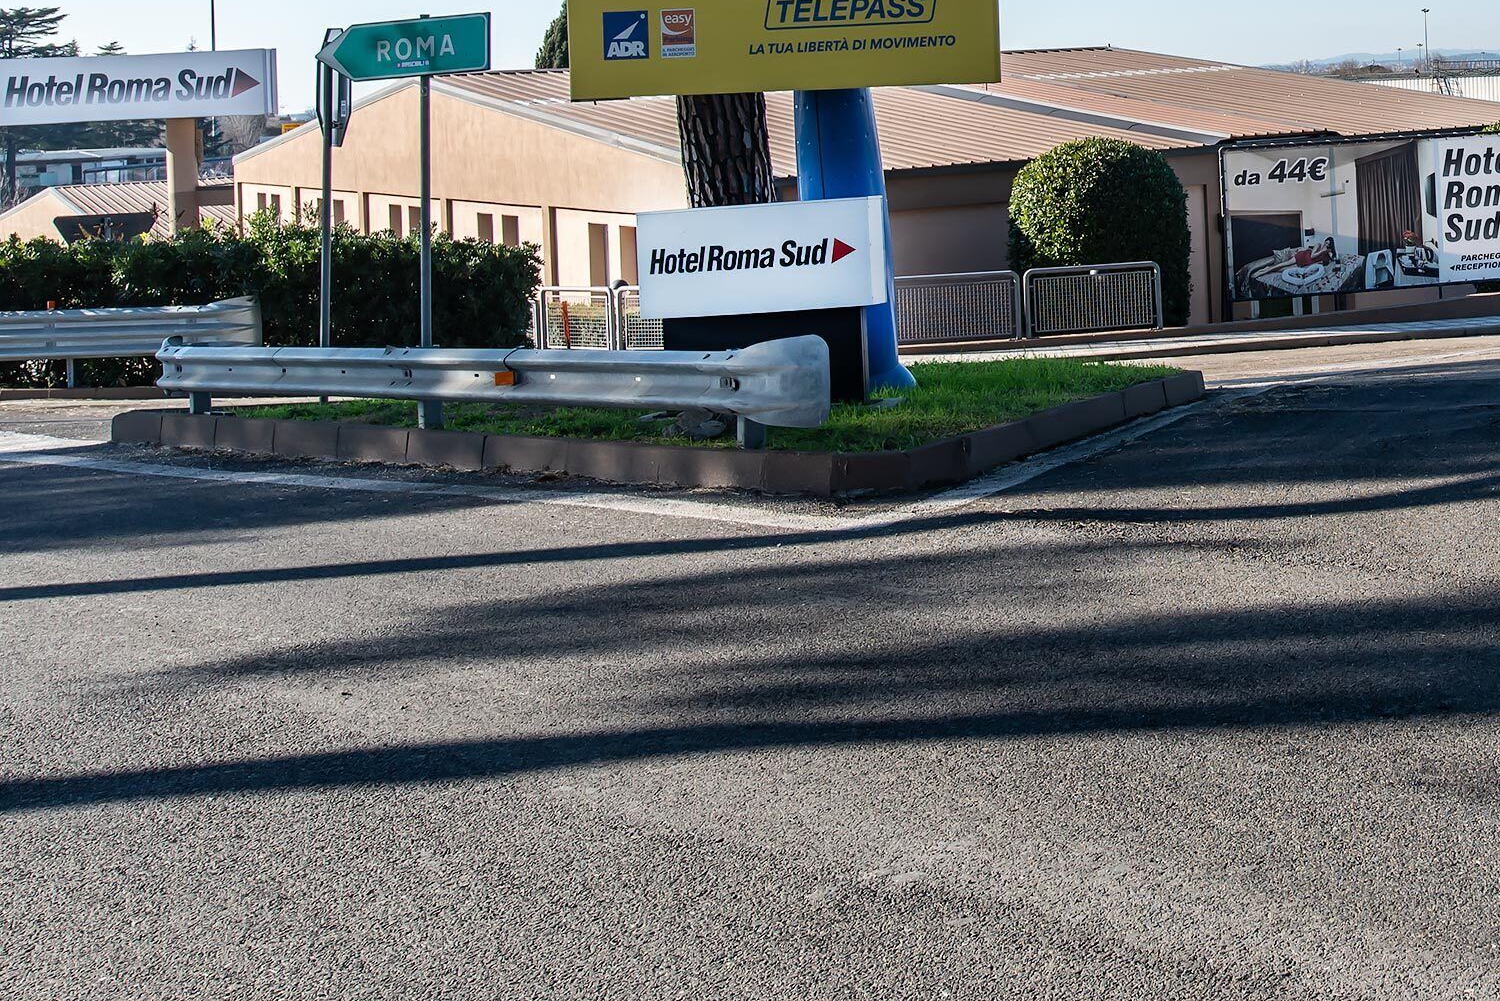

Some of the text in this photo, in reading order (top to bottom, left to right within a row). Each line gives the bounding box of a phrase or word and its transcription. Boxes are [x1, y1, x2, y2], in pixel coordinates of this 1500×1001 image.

[664, 13, 692, 26] easy
[376, 34, 455, 62] ROMA
[607, 40, 646, 58] ADR
[748, 34, 956, 55] LA TUA LIBERTÀ DI MOVIMENTO
[4, 67, 234, 108] Hotel Roma Sud
[1233, 158, 1328, 186] da 44€
[650, 238, 829, 275] Hotel Roma Sud
